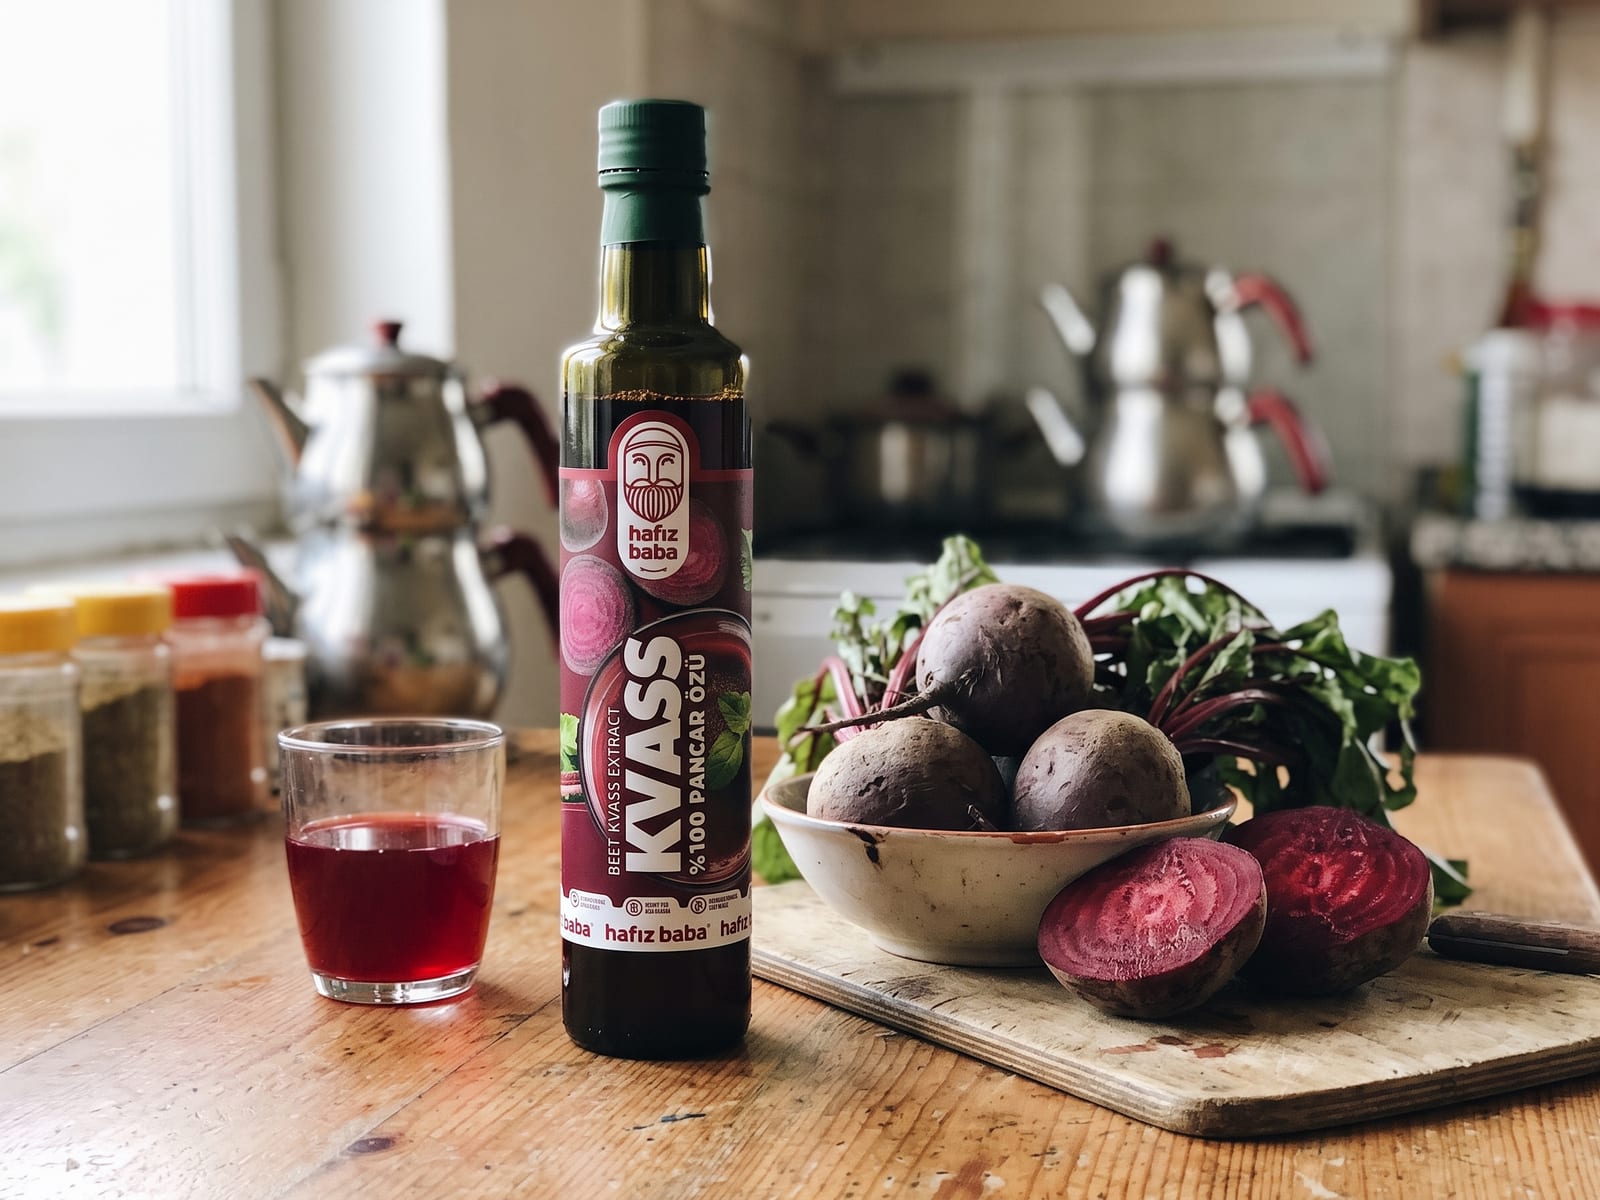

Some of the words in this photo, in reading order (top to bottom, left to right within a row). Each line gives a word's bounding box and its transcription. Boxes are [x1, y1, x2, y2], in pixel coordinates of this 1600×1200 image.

[629, 543, 678, 560] baba
[684, 654, 706, 703] ÖZÜ
[607, 707, 621, 777] EXTRACT
[623, 636, 682, 872] KVASS
[689, 711, 706, 804] PANCAR
[607, 782, 621, 833] KVASS
[607, 838, 621, 876] BEET
[689, 811, 706, 875] %100
[564, 914, 591, 938] baba
[659, 924, 708, 943] baba
